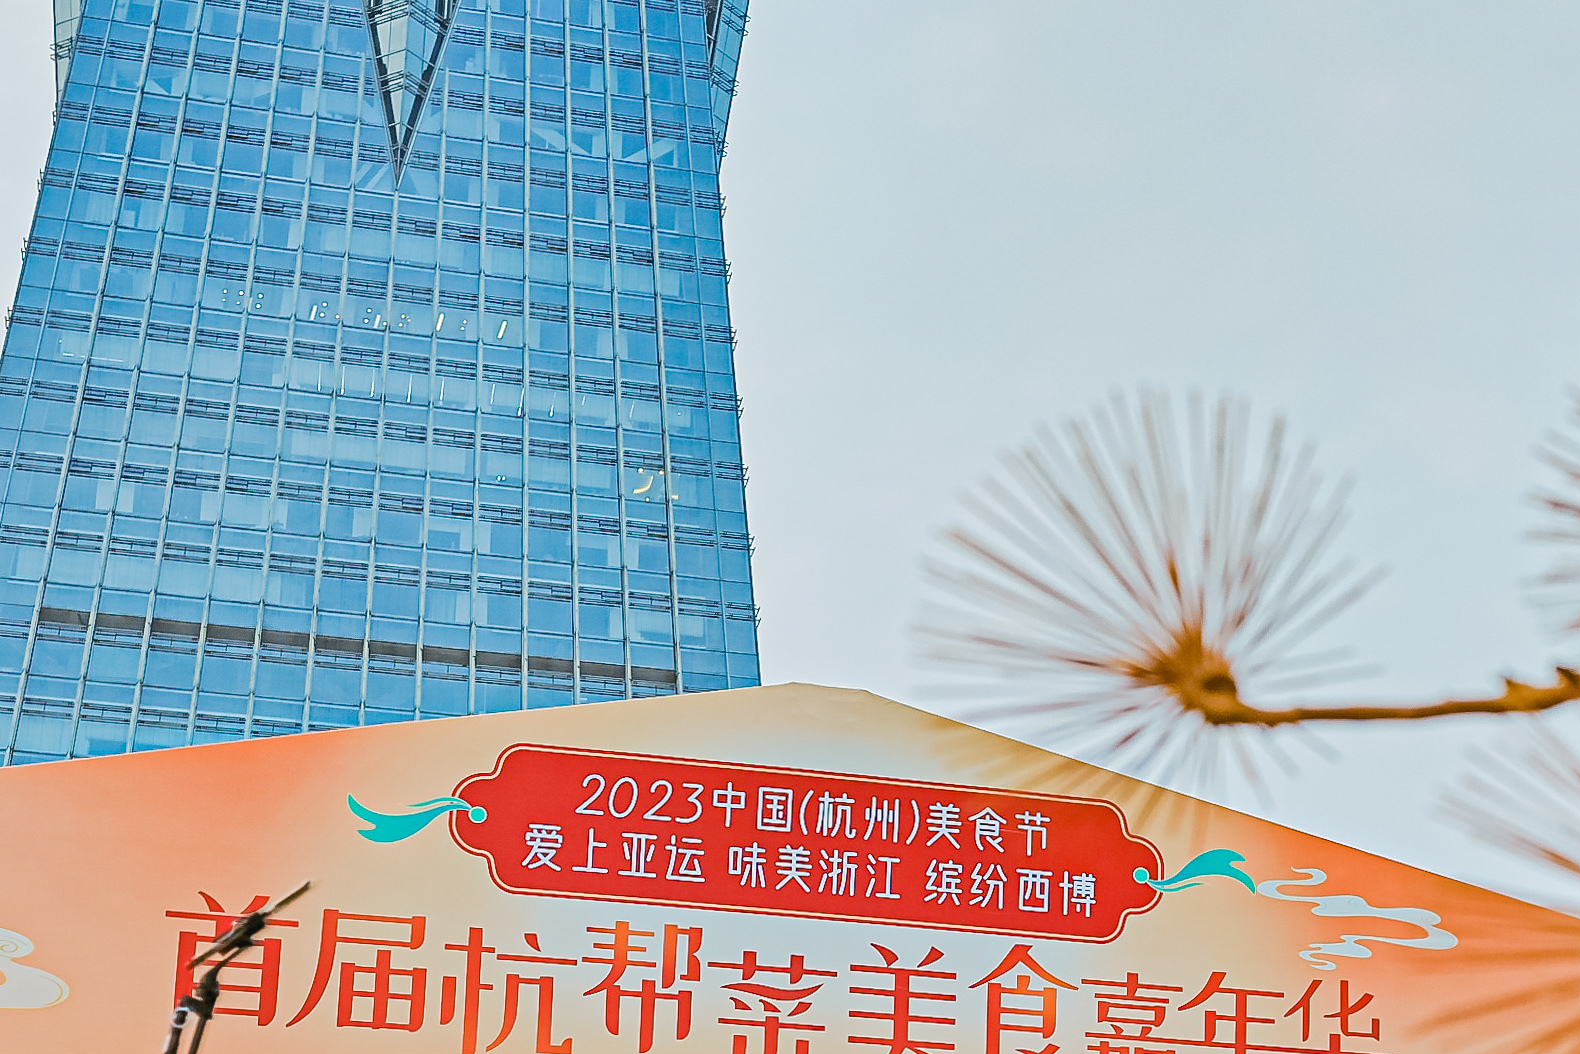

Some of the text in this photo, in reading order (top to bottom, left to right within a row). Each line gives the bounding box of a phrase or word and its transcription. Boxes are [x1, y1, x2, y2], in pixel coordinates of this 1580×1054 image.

[574, 774, 1051, 857] 2023中国(杭州)美食节
[522, 821, 1098, 918] 爱上亚运 味美浙江 缤纷西博
